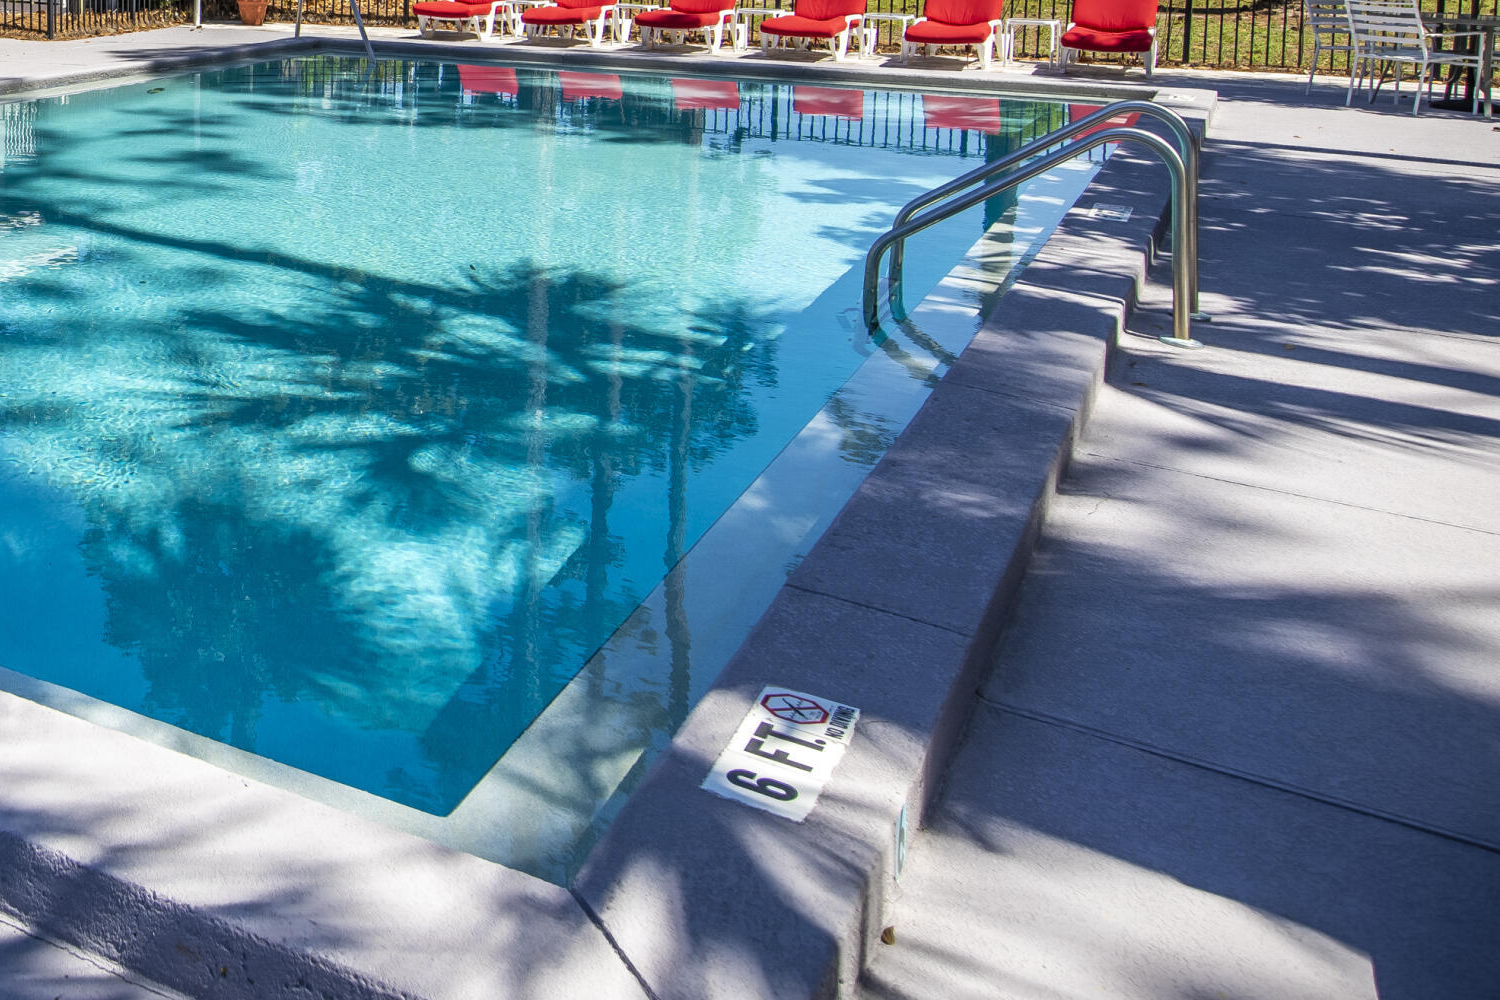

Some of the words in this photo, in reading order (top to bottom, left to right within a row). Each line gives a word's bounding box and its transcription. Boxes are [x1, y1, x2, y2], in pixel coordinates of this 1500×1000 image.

[829, 705, 855, 729] DIVING
[744, 721, 827, 772] FT.
[824, 727, 845, 740] NO
[726, 768, 798, 801] 6
